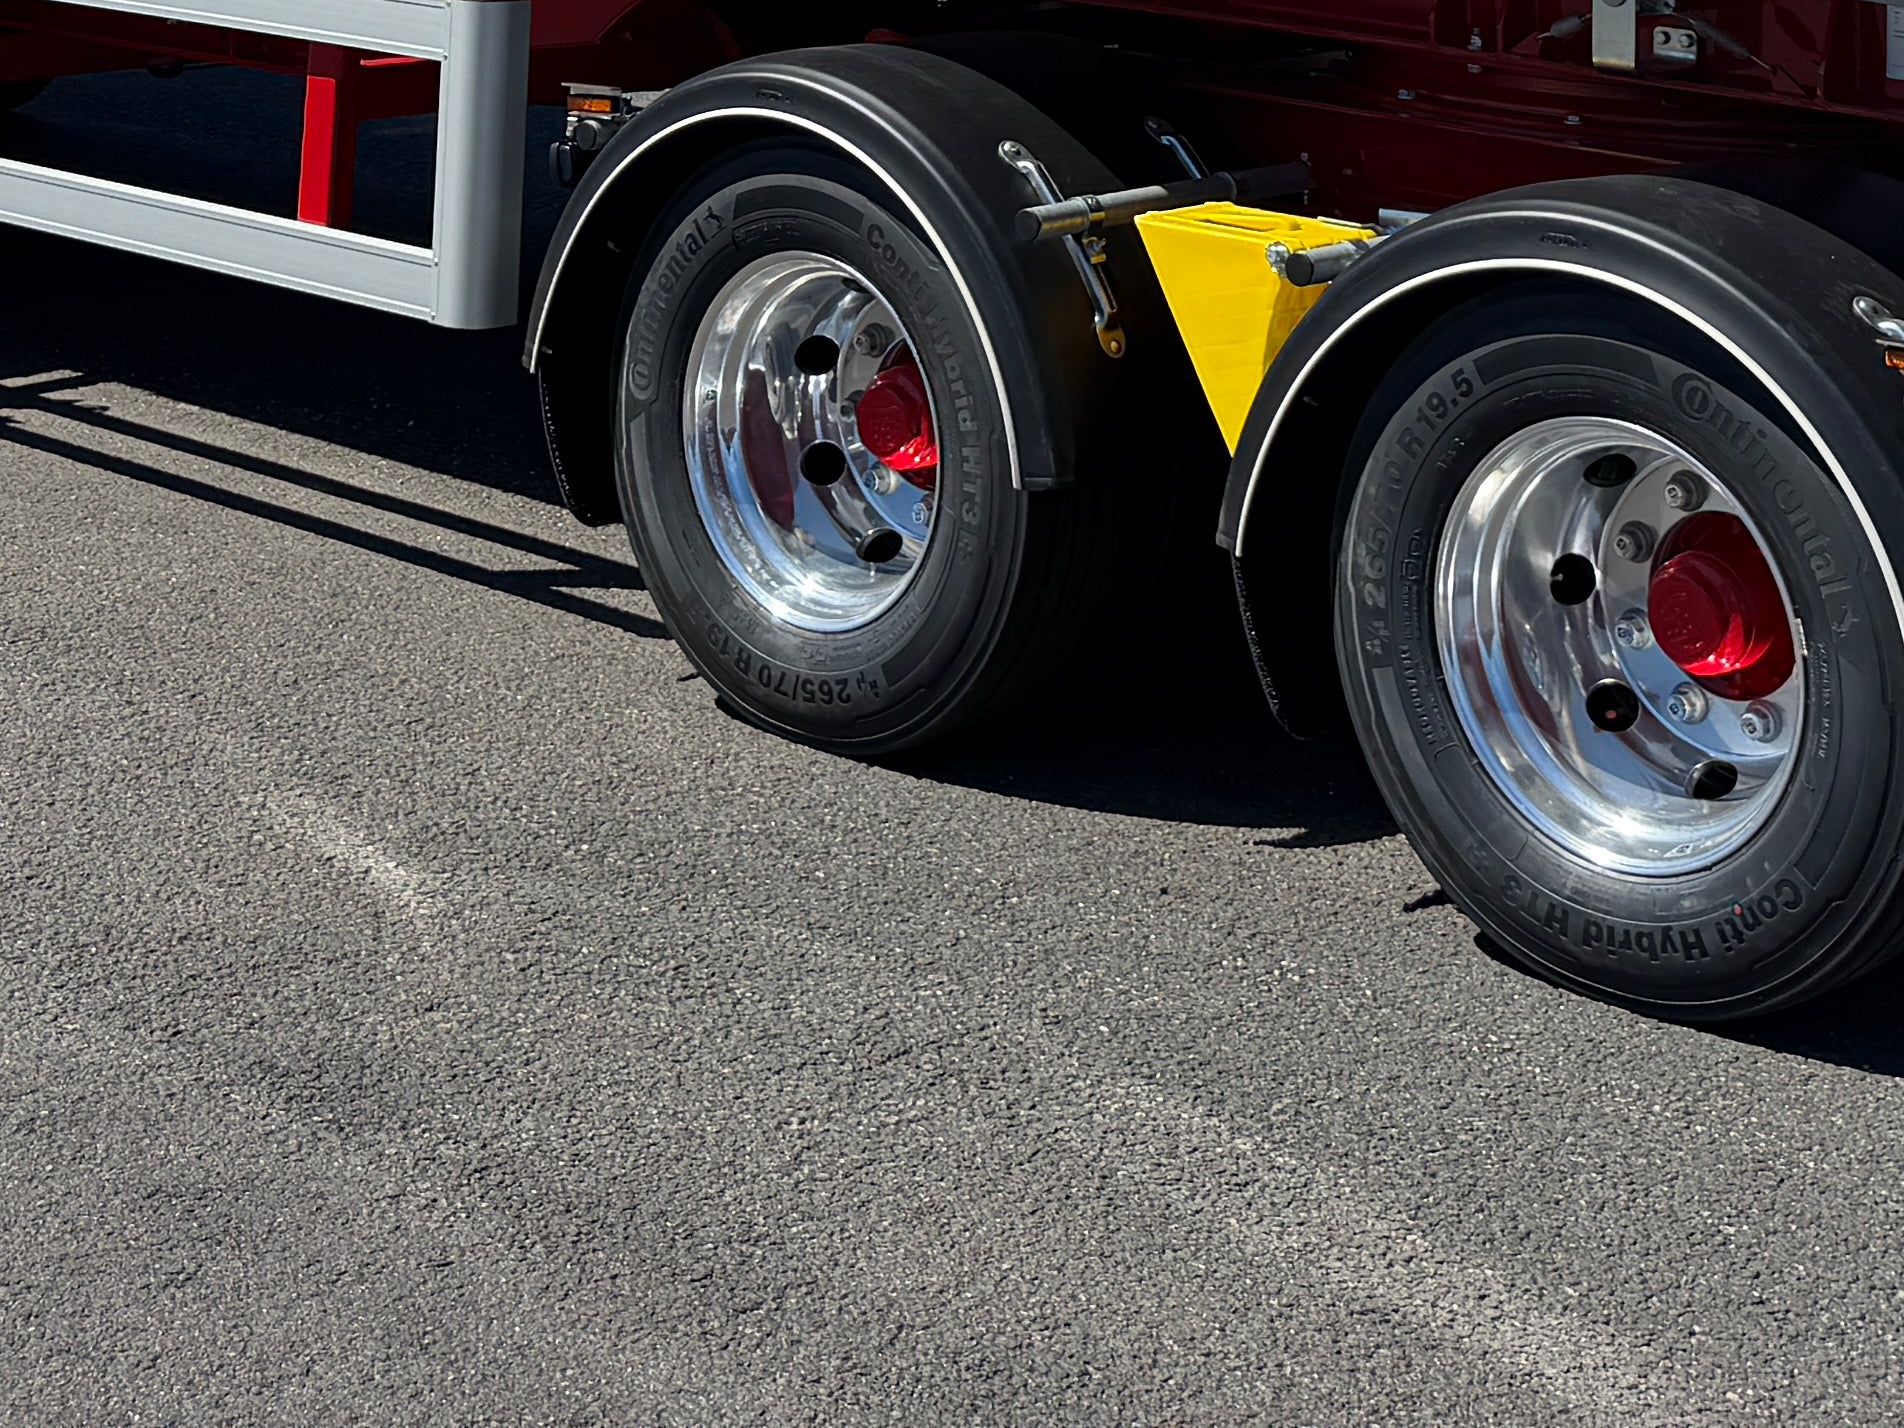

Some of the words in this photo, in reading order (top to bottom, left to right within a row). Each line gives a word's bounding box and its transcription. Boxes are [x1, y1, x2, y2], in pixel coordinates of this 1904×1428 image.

[628, 218, 709, 400] Continental
[1416, 367, 1475, 428] 19.5
[1671, 372, 1853, 598] Continental
[758, 660, 852, 706] 265/70
[1498, 873, 1570, 939] HT3
[1716, 877, 1803, 954] Conti
[1582, 917, 1710, 963] Hybrid
